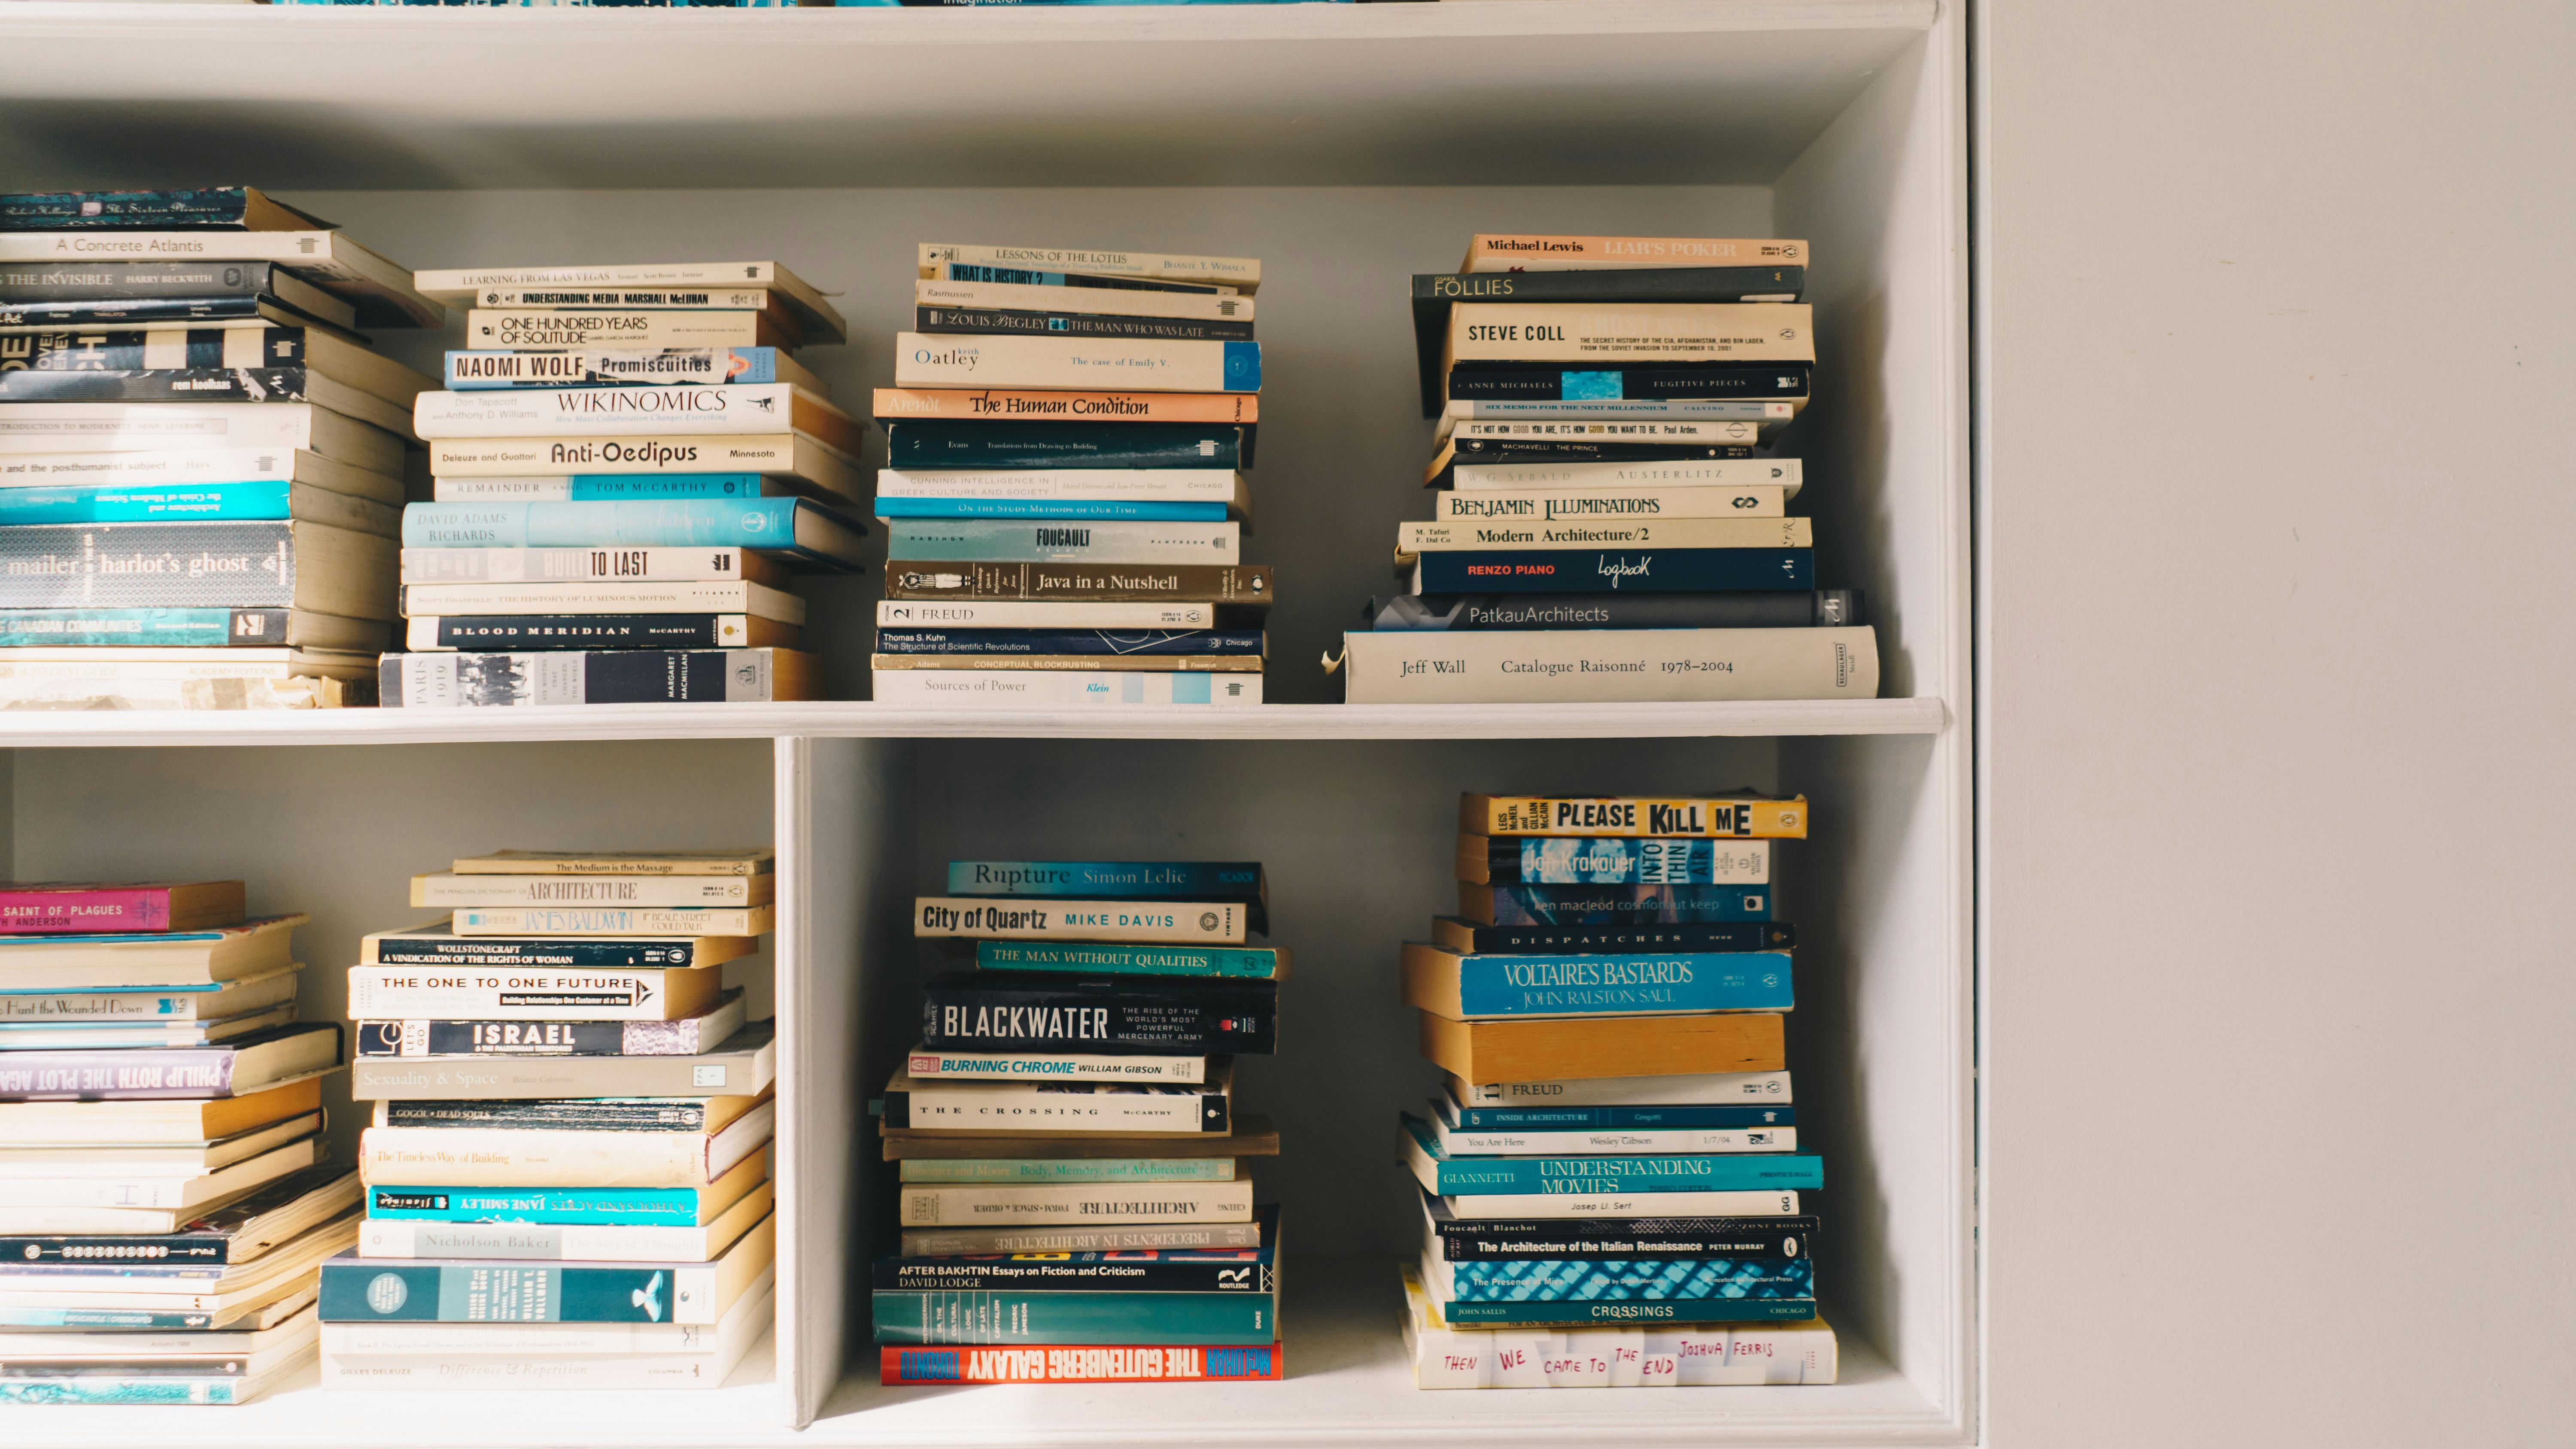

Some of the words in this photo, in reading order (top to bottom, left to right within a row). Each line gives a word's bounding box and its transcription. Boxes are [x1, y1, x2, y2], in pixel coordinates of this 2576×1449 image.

[56, 239, 68, 250] A
[74, 239, 143, 252] Concrete
[149, 239, 203, 252] Atlantis
[1488, 240, 1540, 250] Michael
[1543, 242, 1583, 252] Lewis
[161, 275, 212, 283] BECKWITH
[463, 276, 516, 285] LEARNING
[577, 273, 610, 281] VEGAS
[1435, 279, 1513, 297] FOLLIES
[523, 293, 589, 304] UNDERSTANDING
[593, 294, 619, 304] MEDIA
[625, 294, 666, 304] MARSHALL
[670, 294, 708, 304] McLUHAN
[501, 317, 532, 330] ONE
[538, 317, 603, 330] HUNDRED
[606, 317, 647, 330] YEARS
[501, 331, 520, 344] OF
[523, 331, 586, 344] SOLITUDE
[1469, 326, 1517, 340] STEVE
[1525, 326, 1564, 340] COLL
[457, 358, 520, 377] NAOMI
[531, 357, 583, 376] WOLF
[601, 356, 711, 373] Promiscuities
[1129, 358, 1155, 369] Emily
[1161, 359, 1170, 368] V.
[172, 381, 191, 390] rem
[191, 378, 231, 390] koolhaas
[558, 391, 726, 412] WIKINOMICS
[970, 392, 1001, 415] The
[1006, 398, 1066, 413] Human
[1072, 397, 1148, 414] Condition
[552, 442, 697, 467] Anti-Oedipus
[1451, 498, 1534, 517] BENJAMIN
[1544, 499, 1660, 521] ILLUMINATIONS
[1036, 529, 1090, 547] FOUCAULT
[1477, 530, 1533, 542] Modern
[1542, 528, 1649, 541] Architecture/2
[5, 555, 82, 578] mailer
[98, 553, 180, 576] harlot's
[188, 553, 249, 579] ghost
[1468, 565, 1511, 575] RENZO
[1516, 565, 1555, 574] PIANO
[1598, 554, 1651, 589] Logbook
[1036, 574, 1071, 591] Java
[1076, 575, 1091, 588] in
[1097, 578, 1105, 588] a
[1111, 575, 1177, 589] Nutshell
[923, 610, 973, 619] FREUD
[1470, 606, 1609, 623] PatkauArchitects
[1400, 660, 1428, 677] Jeff
[1433, 660, 1465, 673] Wall
[1501, 659, 1573, 677] Catalogue
[1580, 659, 1646, 673] Raisonné
[1558, 803, 1635, 826] PLEASE
[1650, 805, 1705, 833] KILL
[1716, 805, 1750, 835] ME
[556, 864, 573, 872] The
[575, 864, 609, 872] Medium
[612, 864, 619, 872] is
[621, 863, 634, 872] the
[637, 864, 673, 874] Massage
[527, 882, 637, 900] ARCHITECTURE
[4, 907, 40, 916] SAINT
[48, 906, 62, 916] OF
[70, 905, 122, 915] PLAGUES
[923, 906, 960, 931] City
[965, 908, 982, 928] of
[986, 907, 1046, 932] Quartz
[1066, 914, 1109, 925] MIKE
[1119, 915, 1173, 927] DAVIS
[1512, 935, 1680, 944] DISPATCHES
[437, 945, 519, 954] WOLLSTONECRAFT
[994, 950, 1020, 960] THE
[1026, 951, 1058, 962] MAN
[1065, 952, 1131, 964] WITHOUT
[1136, 955, 1207, 967] QUALITIES
[1504, 963, 1600, 986] VOLTAIRE'S
[1604, 961, 1692, 984] BASTARDS
[382, 978, 418, 987] THE
[427, 978, 466, 987] ONE
[476, 978, 499, 987] TO
[509, 978, 547, 987] ONE
[557, 979, 632, 988] FUTURE
[945, 1006, 1107, 1039] BLACKWATER
[474, 1024, 576, 1045] ISRAEL
[941, 1060, 1009, 1072] BURNING
[1012, 1061, 1075, 1073] CHROME
[1540, 1160, 1711, 1176] UNDERSTANDING
[1443, 1173, 1514, 1183] GIANNETTI
[1542, 1179, 1618, 1194] MOVIES
[1478, 1242, 1498, 1252] The
[1501, 1242, 1566, 1252] Architecture
[1569, 1242, 1580, 1252] of
[1581, 1242, 1599, 1252] the
[1601, 1241, 1634, 1251] Italian
[1637, 1241, 1703, 1251] Renaissance
[899, 1267, 936, 1275] AFTER
[938, 1267, 990, 1275] BAKHTIN
[993, 1266, 1024, 1278] Essays
[1042, 1266, 1075, 1276] Fiction
[1078, 1267, 1097, 1276] and
[1099, 1267, 1145, 1276] Criticism
[899, 1277, 936, 1288] DAVID
[939, 1277, 981, 1288] LODGE
[1592, 1306, 1673, 1318] CROSSINGS
[1678, 1341, 1722, 1358] JOSHUA
[1733, 1342, 1772, 1357] FERRIS
[967, 1350, 1045, 1379] GALAXY
[1048, 1349, 1163, 1379] GUTENBERG
[1166, 1349, 1201, 1377] THE
[1445, 1356, 1477, 1370] THEN
[1499, 1350, 1525, 1370] WE
[1544, 1360, 1581, 1374] CAME
[1590, 1358, 1606, 1372] TO
[1616, 1348, 1638, 1362] THE
[1643, 1358, 1674, 1375] END
